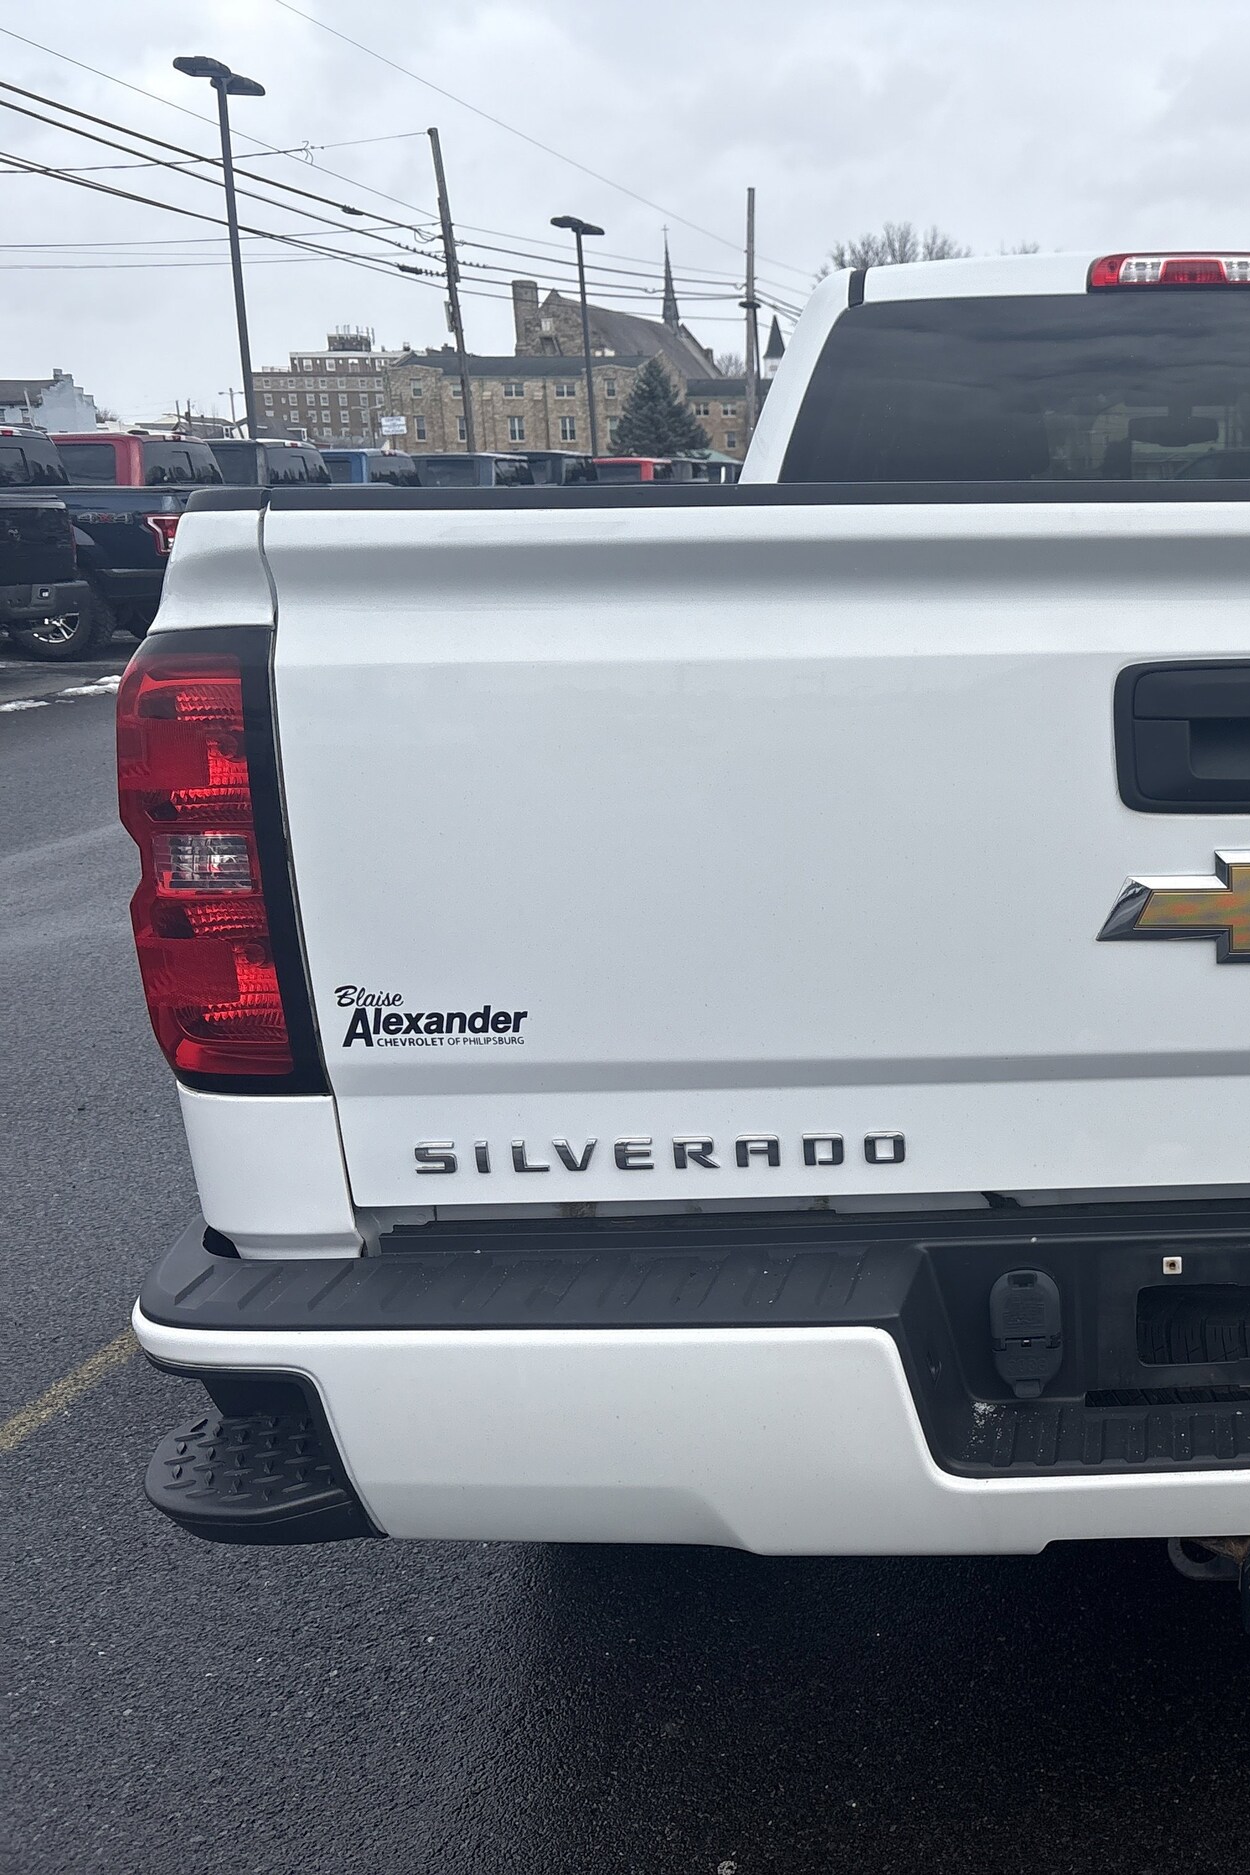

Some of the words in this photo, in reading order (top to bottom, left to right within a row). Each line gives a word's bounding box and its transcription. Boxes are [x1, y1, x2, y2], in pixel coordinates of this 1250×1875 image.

[334, 985, 404, 1007] Blaise
[342, 1005, 528, 1047] Alexander
[376, 1037, 444, 1047] CHEVROLET
[447, 1037, 461, 1046] OF
[463, 1036, 525, 1046] PHILIPSBURG
[414, 1130, 907, 1174] SILVERADO
